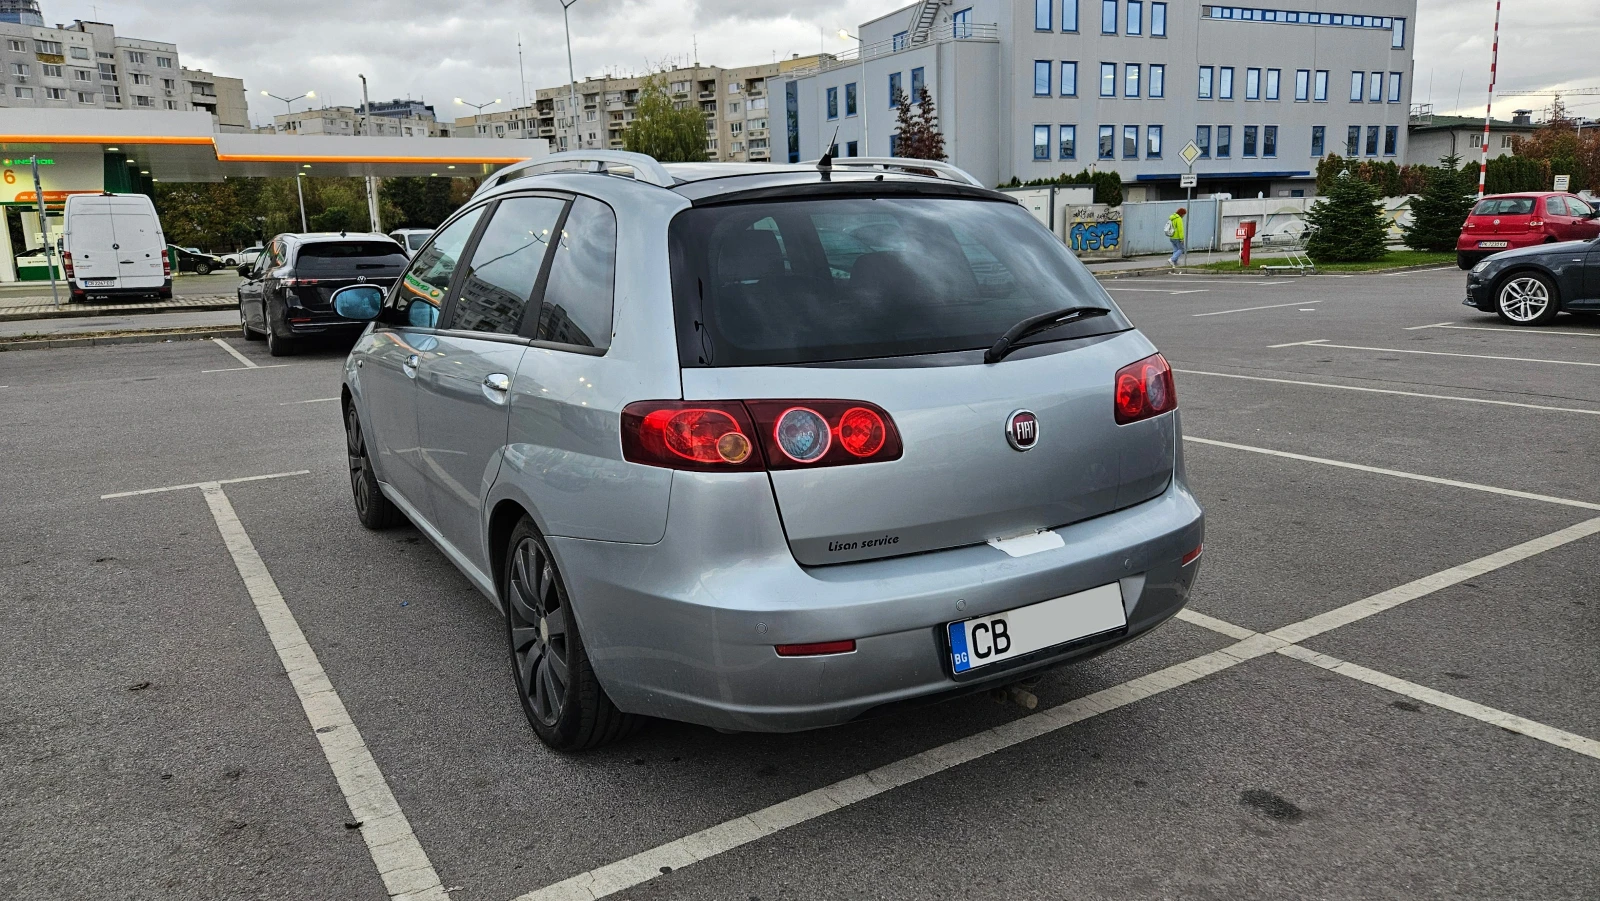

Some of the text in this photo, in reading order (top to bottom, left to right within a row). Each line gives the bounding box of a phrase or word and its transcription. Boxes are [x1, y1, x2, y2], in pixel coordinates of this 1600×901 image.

[4, 169, 16, 184] 6
[1016, 421, 1034, 440] FIAT
[828, 535, 900, 552] Lisan service
[971, 618, 1011, 659] CB
[954, 652, 968, 665] BG
